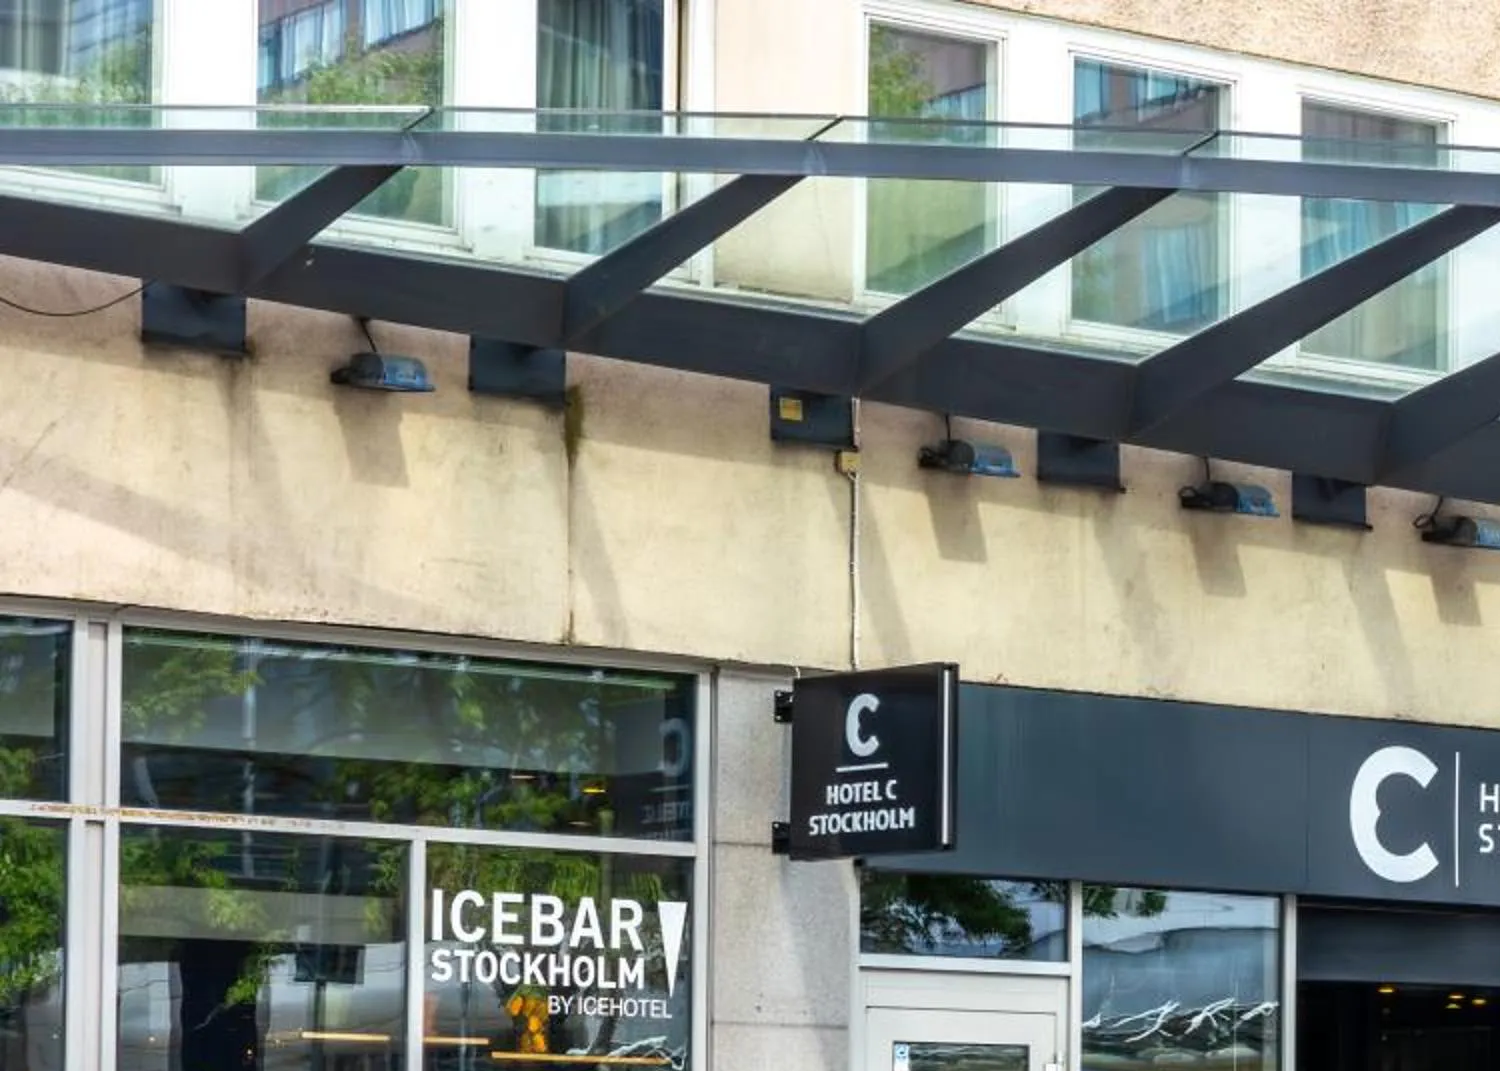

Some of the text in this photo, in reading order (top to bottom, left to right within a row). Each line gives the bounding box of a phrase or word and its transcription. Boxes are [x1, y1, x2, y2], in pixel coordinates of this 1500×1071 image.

[845, 693, 880, 757] C
[826, 779, 898, 805] HOTEL C
[809, 807, 916, 836] STOCKHOLM
[1350, 746, 1439, 883] C
[432, 888, 644, 949] ICEBAR
[431, 948, 645, 990] STOCKHOLM
[548, 996, 672, 1018] BY ICEHOTEL
